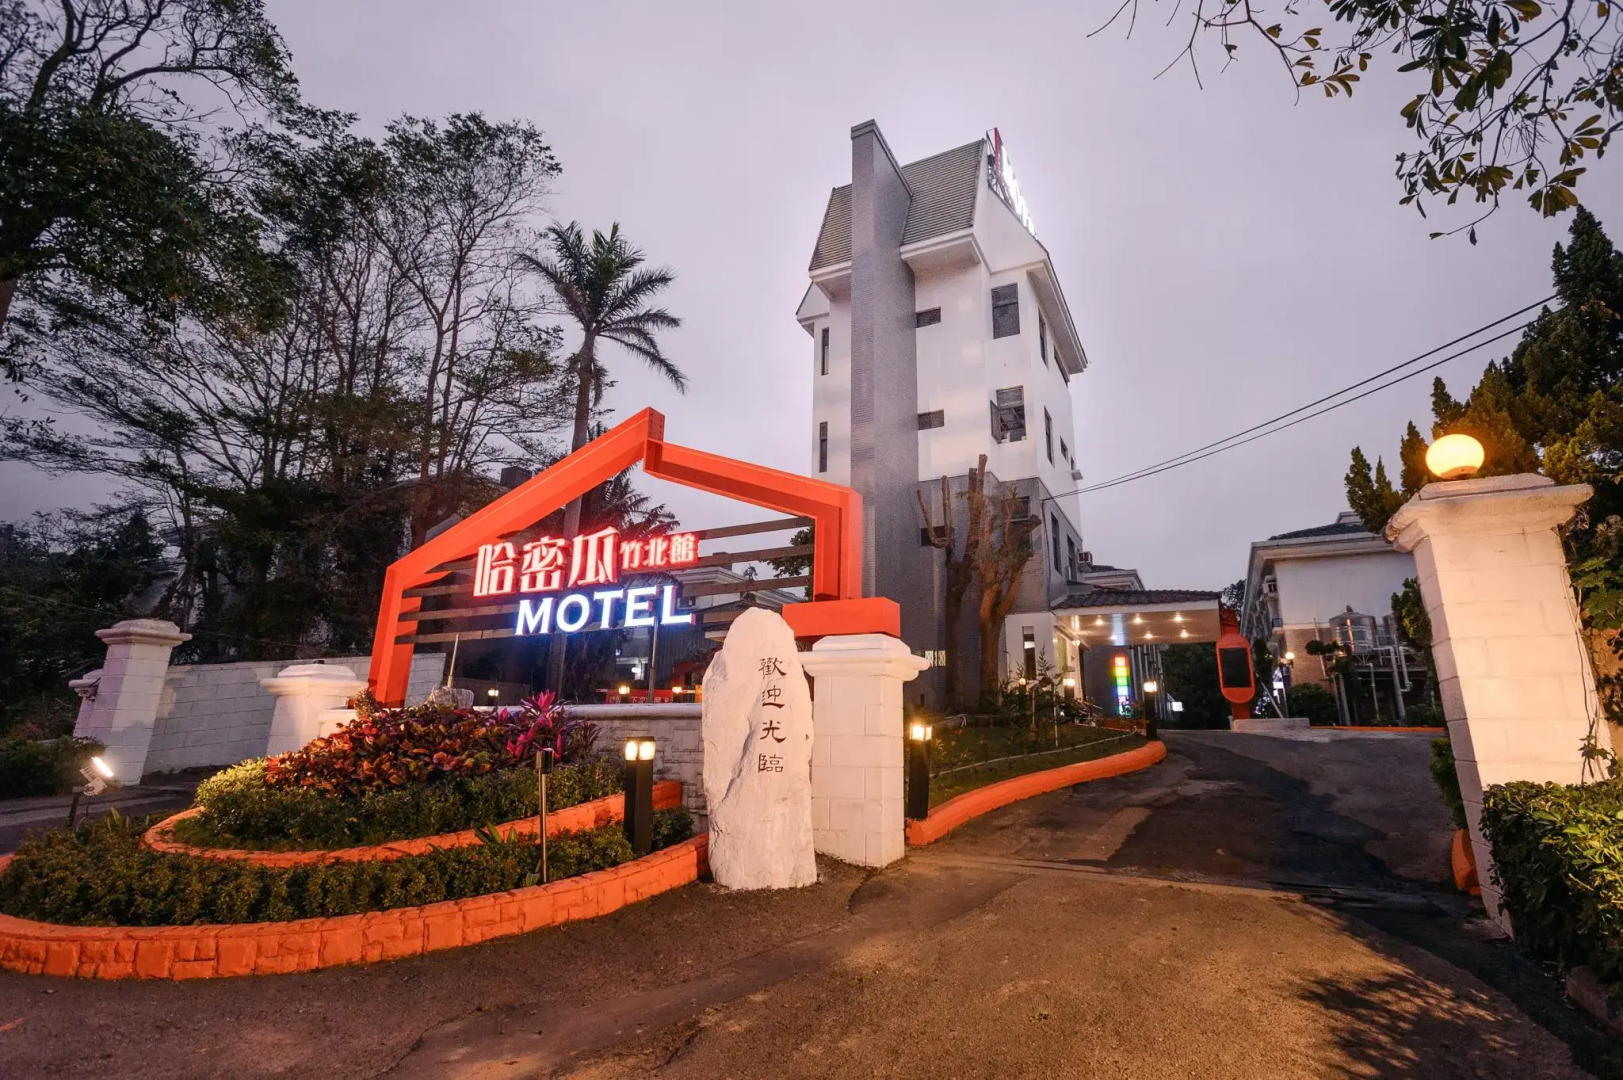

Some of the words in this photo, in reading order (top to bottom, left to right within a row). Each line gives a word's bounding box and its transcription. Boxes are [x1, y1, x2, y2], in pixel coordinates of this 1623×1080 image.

[473, 526, 619, 597] 哈密瓜
[620, 533, 696, 570] 竹北館
[515, 585, 693, 636] MOTEL
[758, 657, 787, 773] 歡迎光臨
